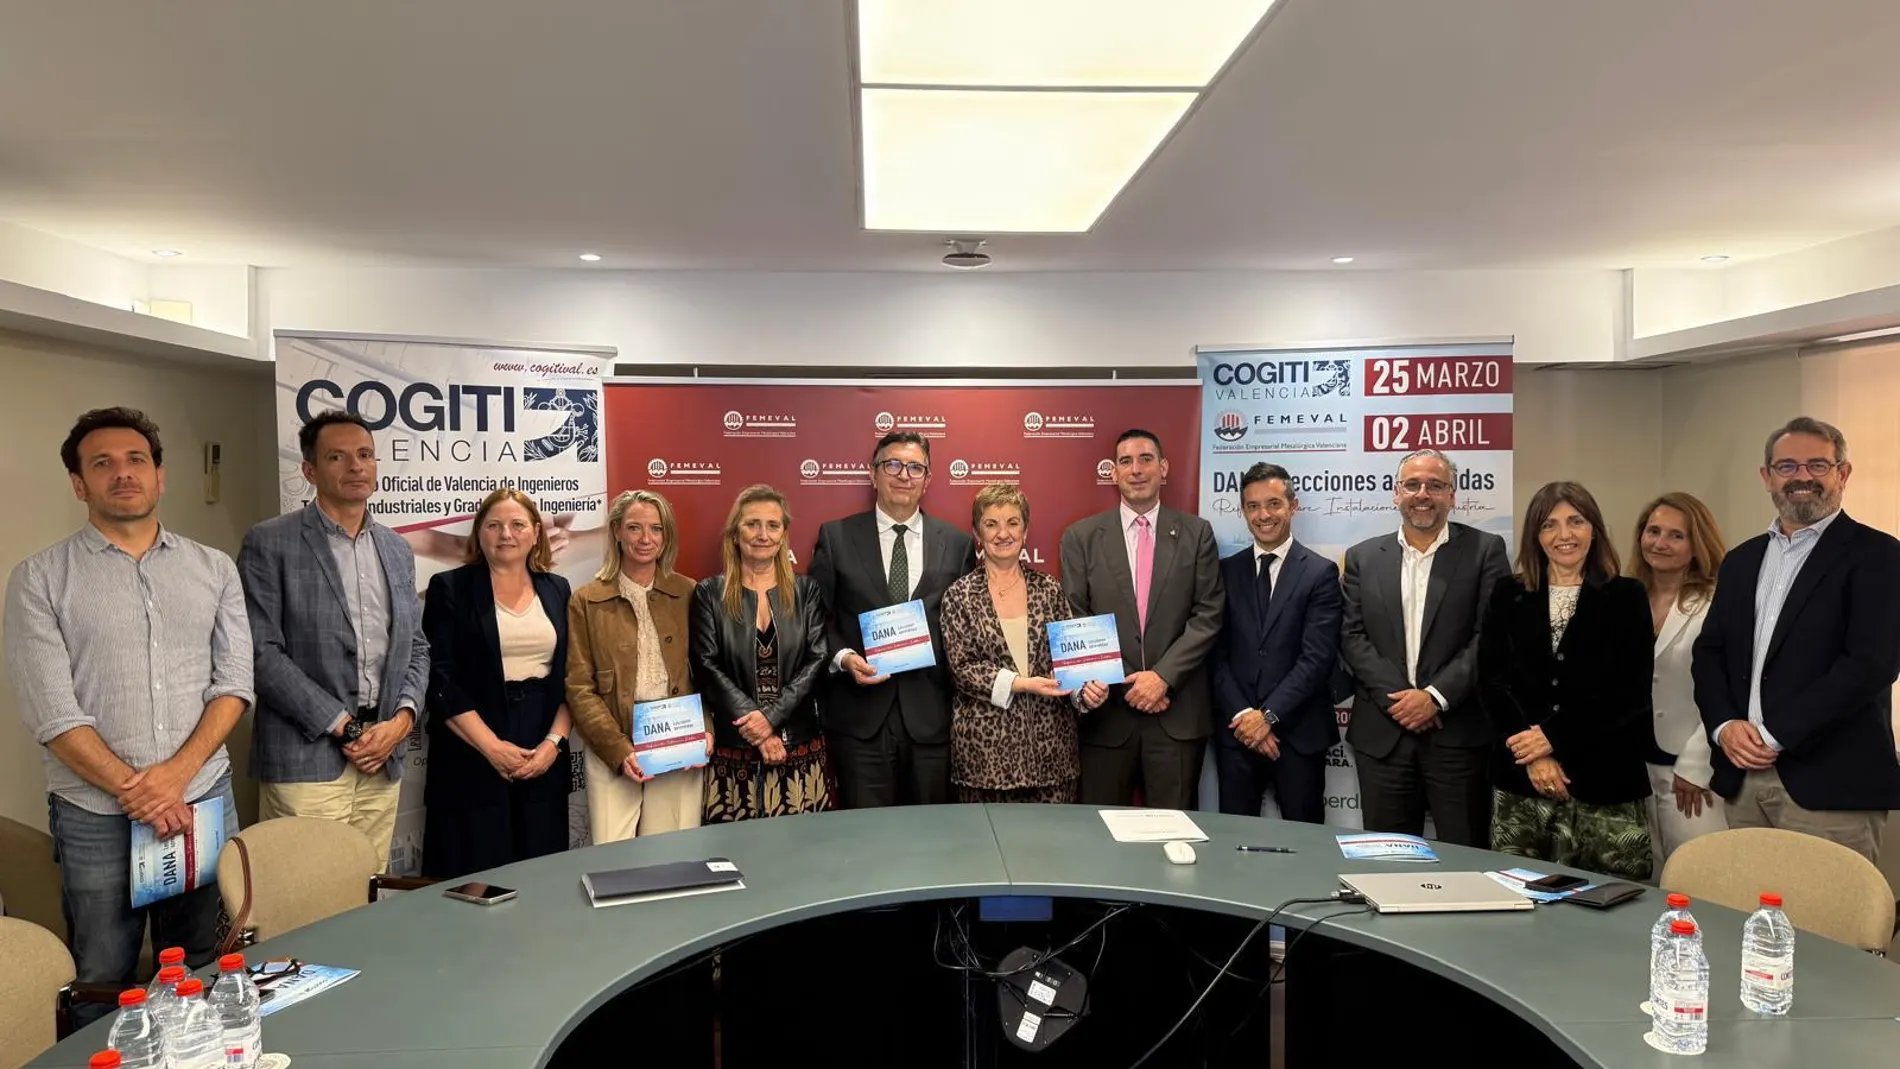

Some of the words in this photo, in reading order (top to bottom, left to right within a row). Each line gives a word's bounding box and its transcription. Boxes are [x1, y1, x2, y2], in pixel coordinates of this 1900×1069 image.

[1213, 359, 1309, 386] COGITI
[1373, 359, 1410, 394] 25
[1417, 360, 1500, 388] MARZO
[1215, 386, 1313, 400] VALENCIA
[296, 379, 515, 432] COGITI
[1254, 413, 1347, 425] FEMEVAL
[1372, 416, 1409, 449] 02
[1418, 419, 1490, 446] ABRIL
[376, 439, 517, 462] ENCIA
[382, 475, 424, 491] Oficial
[427, 477, 441, 491] de
[445, 477, 496, 492] Valencia
[500, 477, 514, 491] de
[518, 477, 579, 494] Ingenieros
[1292, 470, 1376, 492] ecciones
[368, 498, 440, 514] ndustriales
[444, 500, 451, 515] y
[1322, 497, 1399, 517] Instalacione
[872, 626, 897, 641] DANA
[1060, 640, 1087, 653] DANA
[643, 721, 671, 736] DANA
[162, 851, 177, 886] DANA
